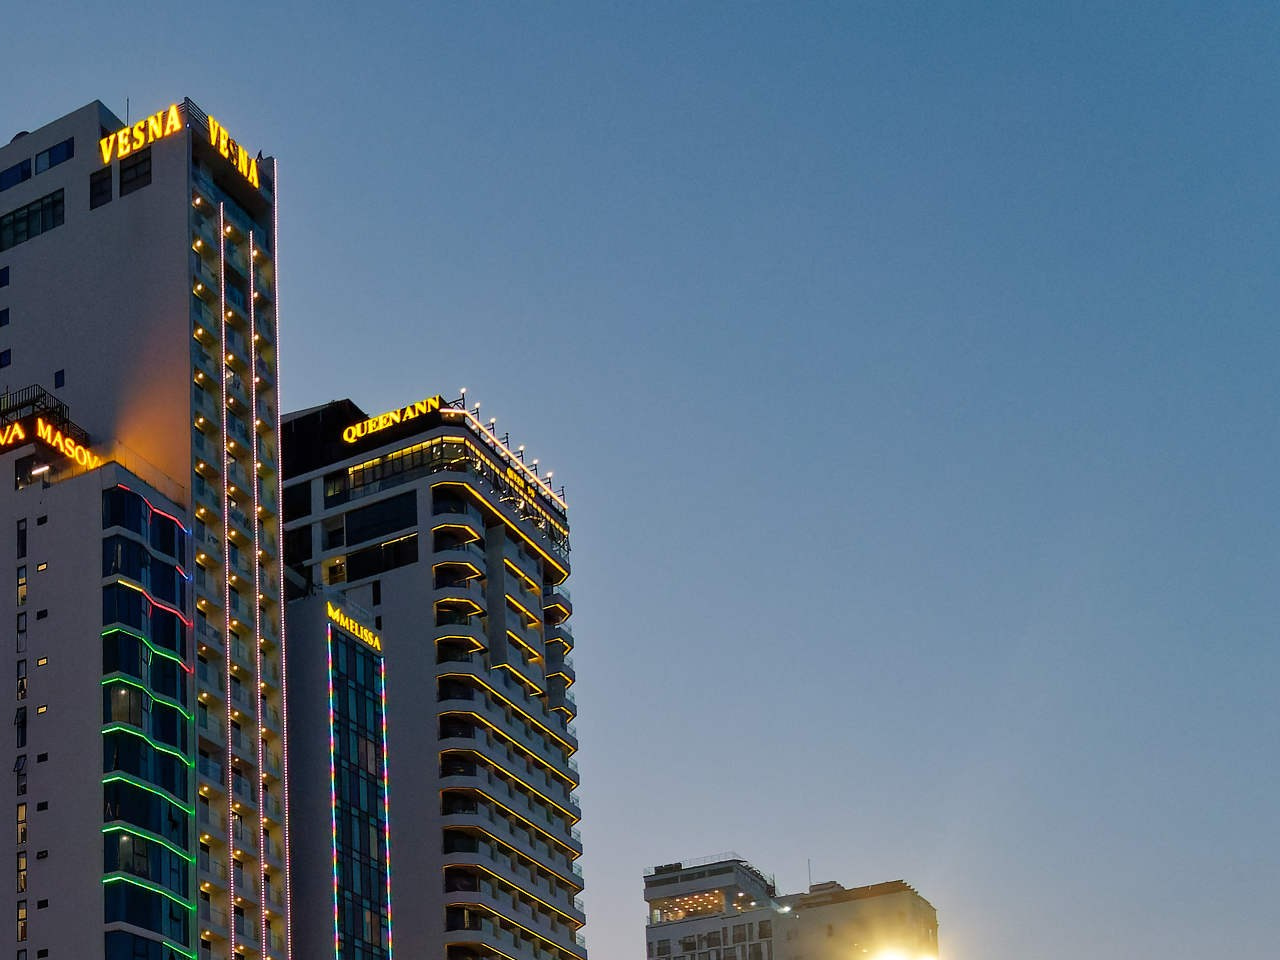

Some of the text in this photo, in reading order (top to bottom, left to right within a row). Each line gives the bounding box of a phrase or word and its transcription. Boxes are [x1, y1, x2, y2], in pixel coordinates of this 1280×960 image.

[100, 104, 181, 165] VESNA
[37, 418, 103, 470] MASOV
[343, 395, 440, 443] QUEEN ANN
